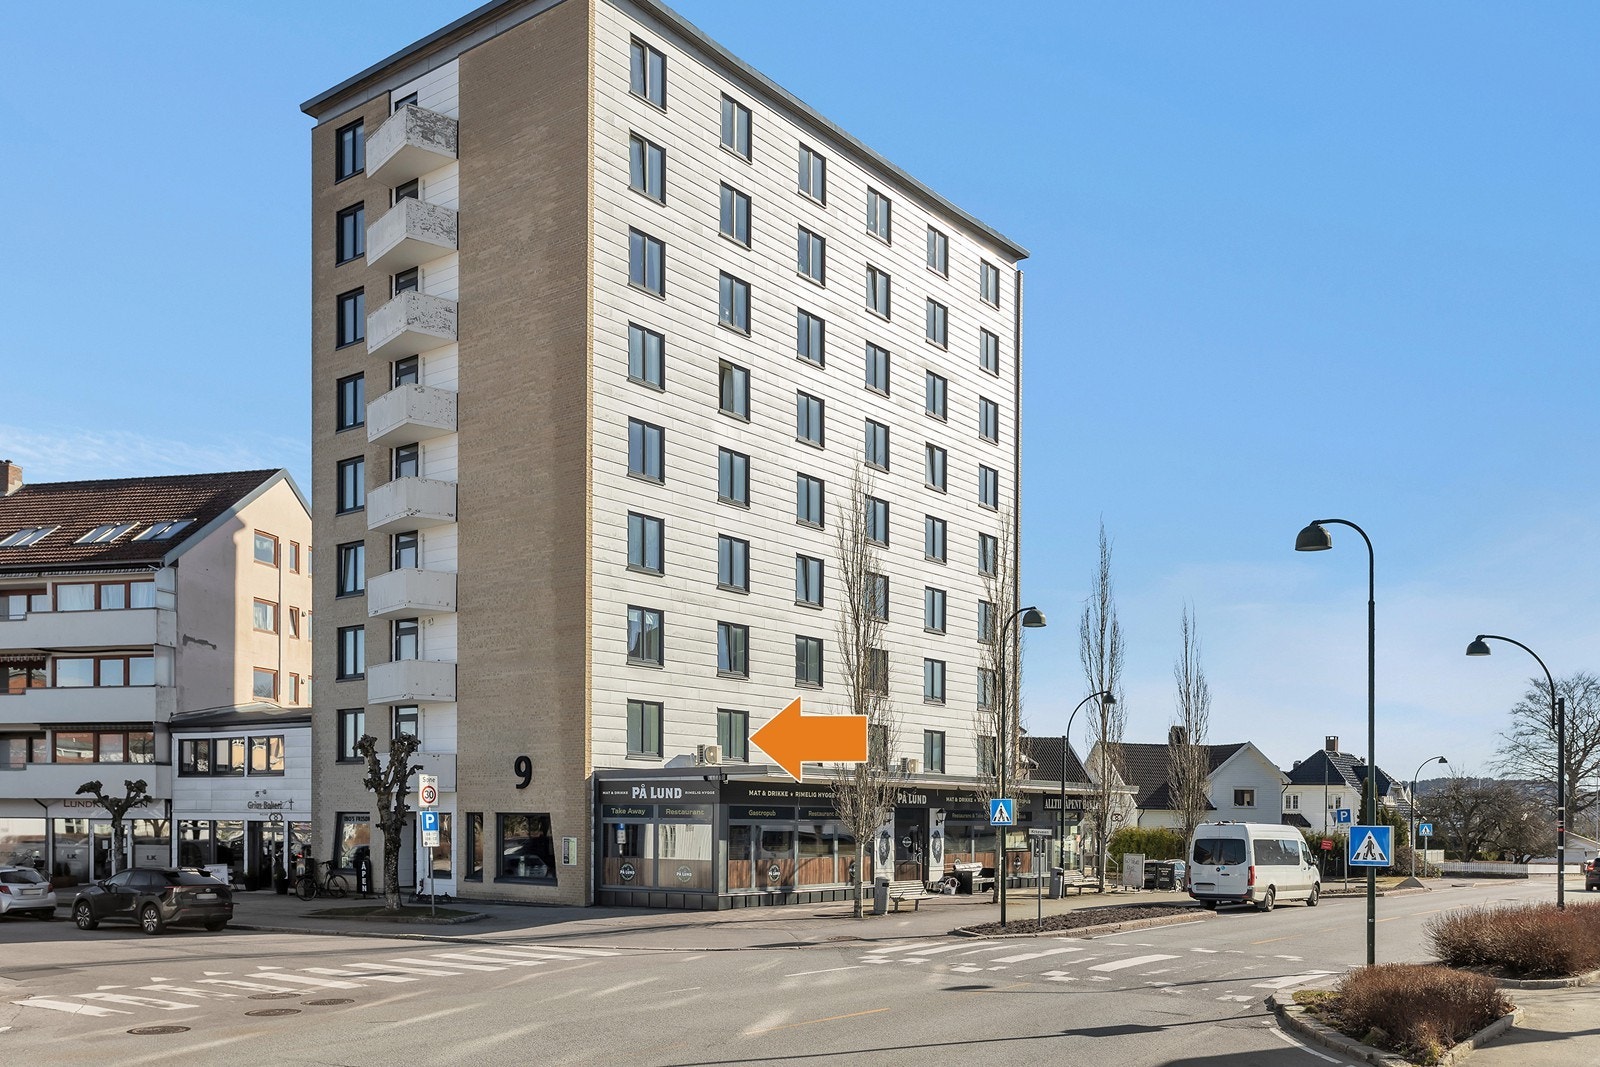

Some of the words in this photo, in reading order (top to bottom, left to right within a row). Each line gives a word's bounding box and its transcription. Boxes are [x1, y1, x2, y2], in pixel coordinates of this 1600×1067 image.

[514, 755, 532, 789] 9
[424, 790, 434, 799] 30
[632, 783, 647, 799] PÅ
[650, 786, 682, 799] LUND
[897, 790, 908, 804] PÅ
[908, 793, 927, 805] LUND
[1044, 798, 1062, 809] ALLTI
[627, 807, 646, 816] Away
[748, 809, 776, 817] Gastropub
[1340, 810, 1348, 822] P
[425, 813, 435, 829] P
